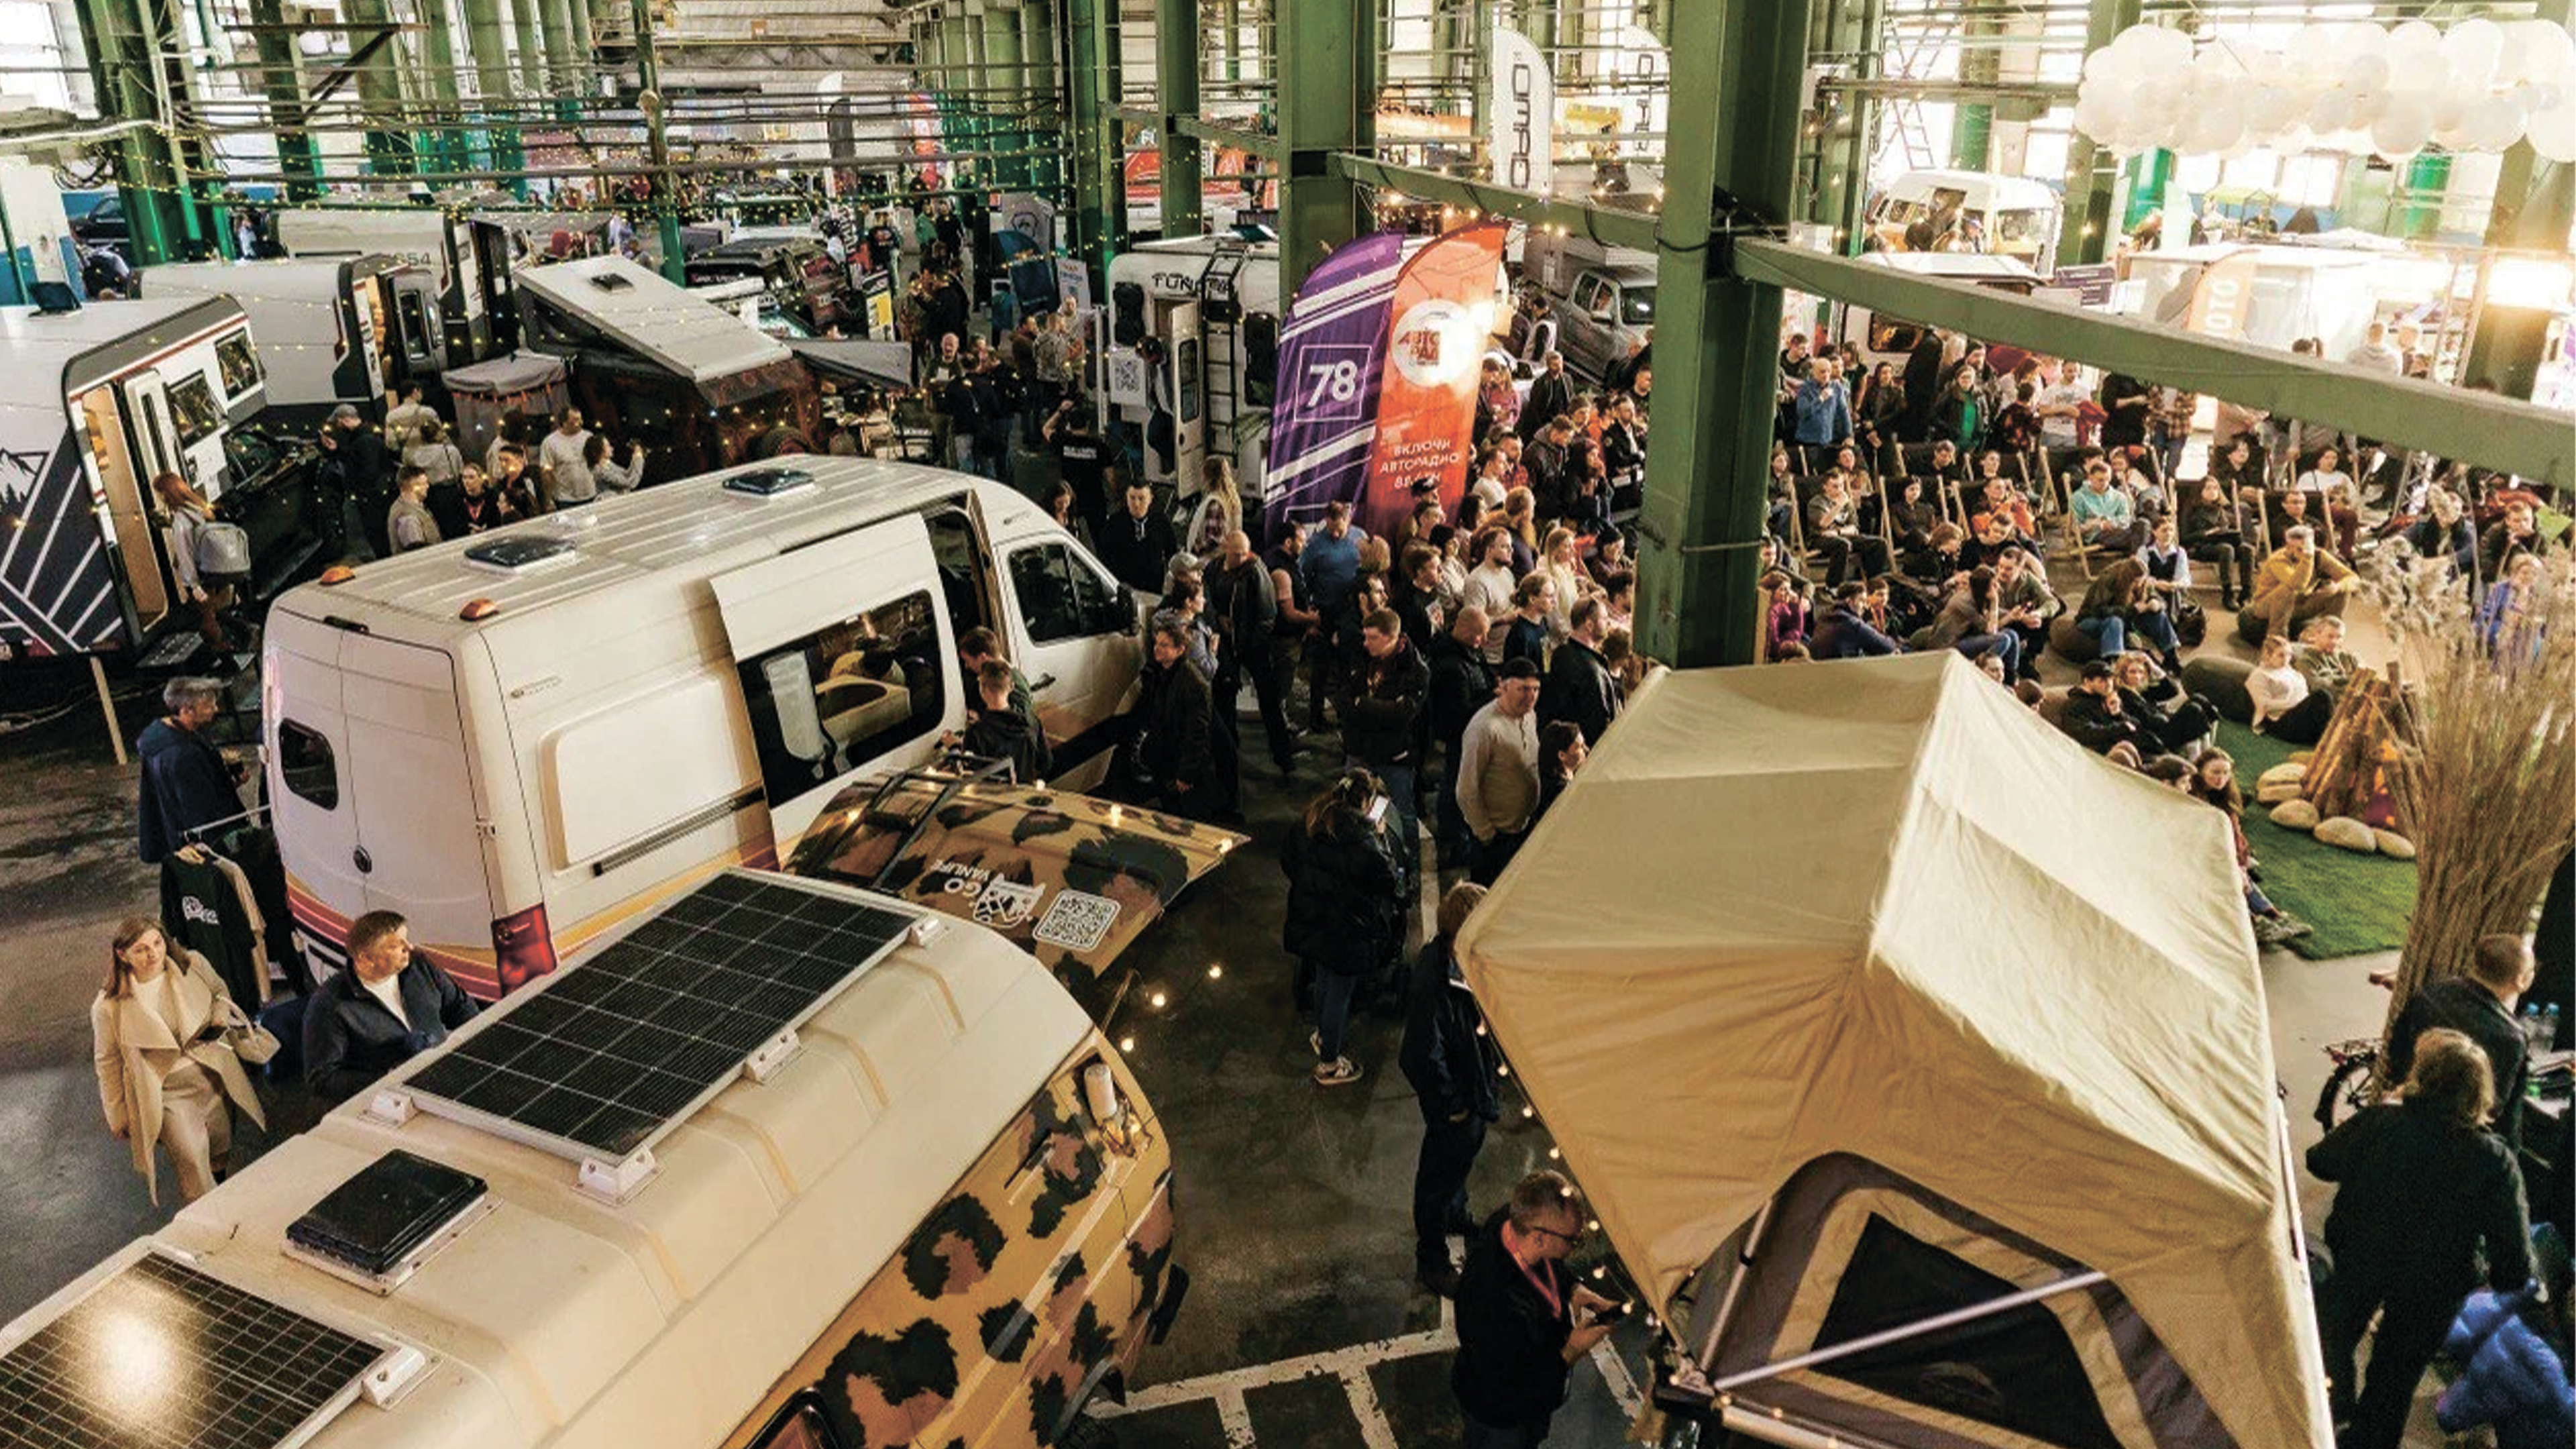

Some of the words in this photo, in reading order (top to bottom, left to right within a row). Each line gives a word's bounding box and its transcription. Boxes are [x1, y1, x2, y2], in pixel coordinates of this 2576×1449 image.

[1309, 360, 1357, 407] 78
[1394, 439, 1450, 457] ВКЛЮЧИ
[1380, 452, 1458, 474] АВТОРАДИО
[944, 877, 981, 896] GO
